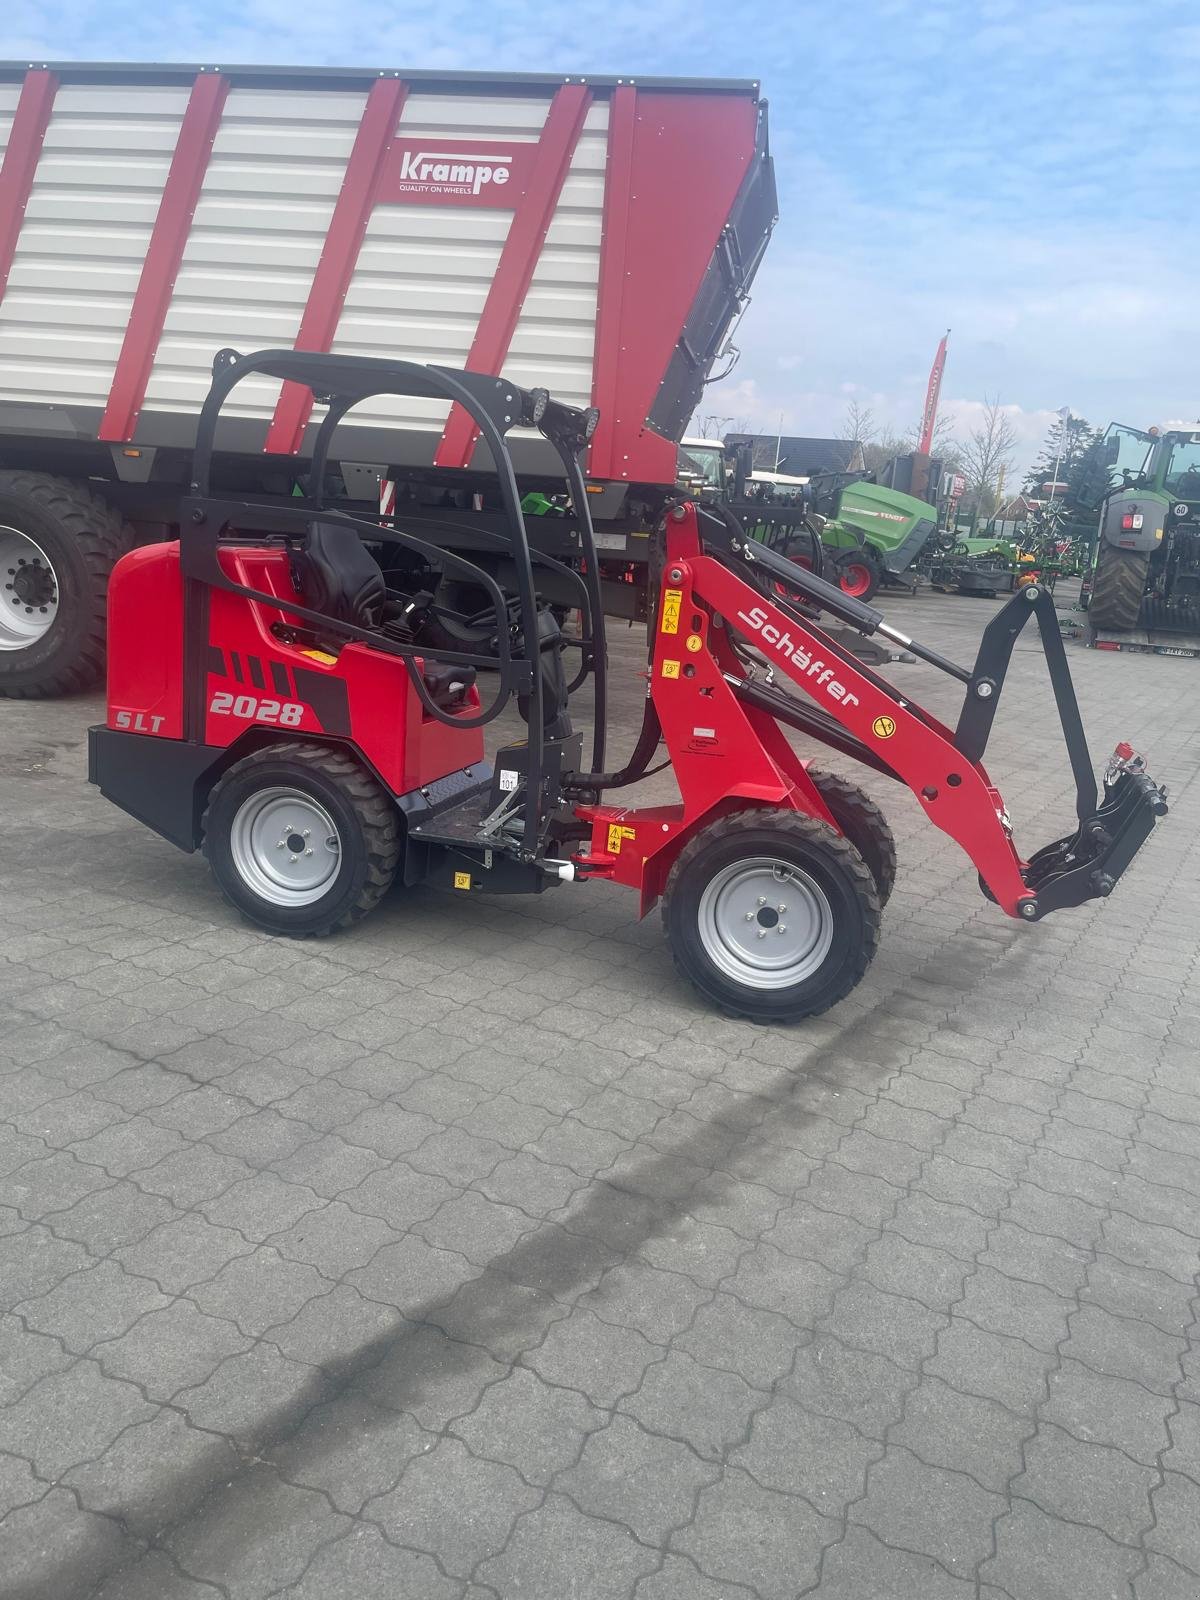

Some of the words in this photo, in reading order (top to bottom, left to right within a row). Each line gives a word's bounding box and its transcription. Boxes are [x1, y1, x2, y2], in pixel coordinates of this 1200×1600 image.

[400, 152, 512, 195] Krampe
[399, 185, 429, 193] QUALITY
[443, 187, 472, 195] WHEELS
[880, 512, 905, 521] FENDT
[1176, 506, 1186, 514] 60
[737, 607, 860, 708] Schäffer
[209, 691, 304, 727] 2028
[115, 711, 166, 733] SLT
[502, 779, 513, 789] 101
